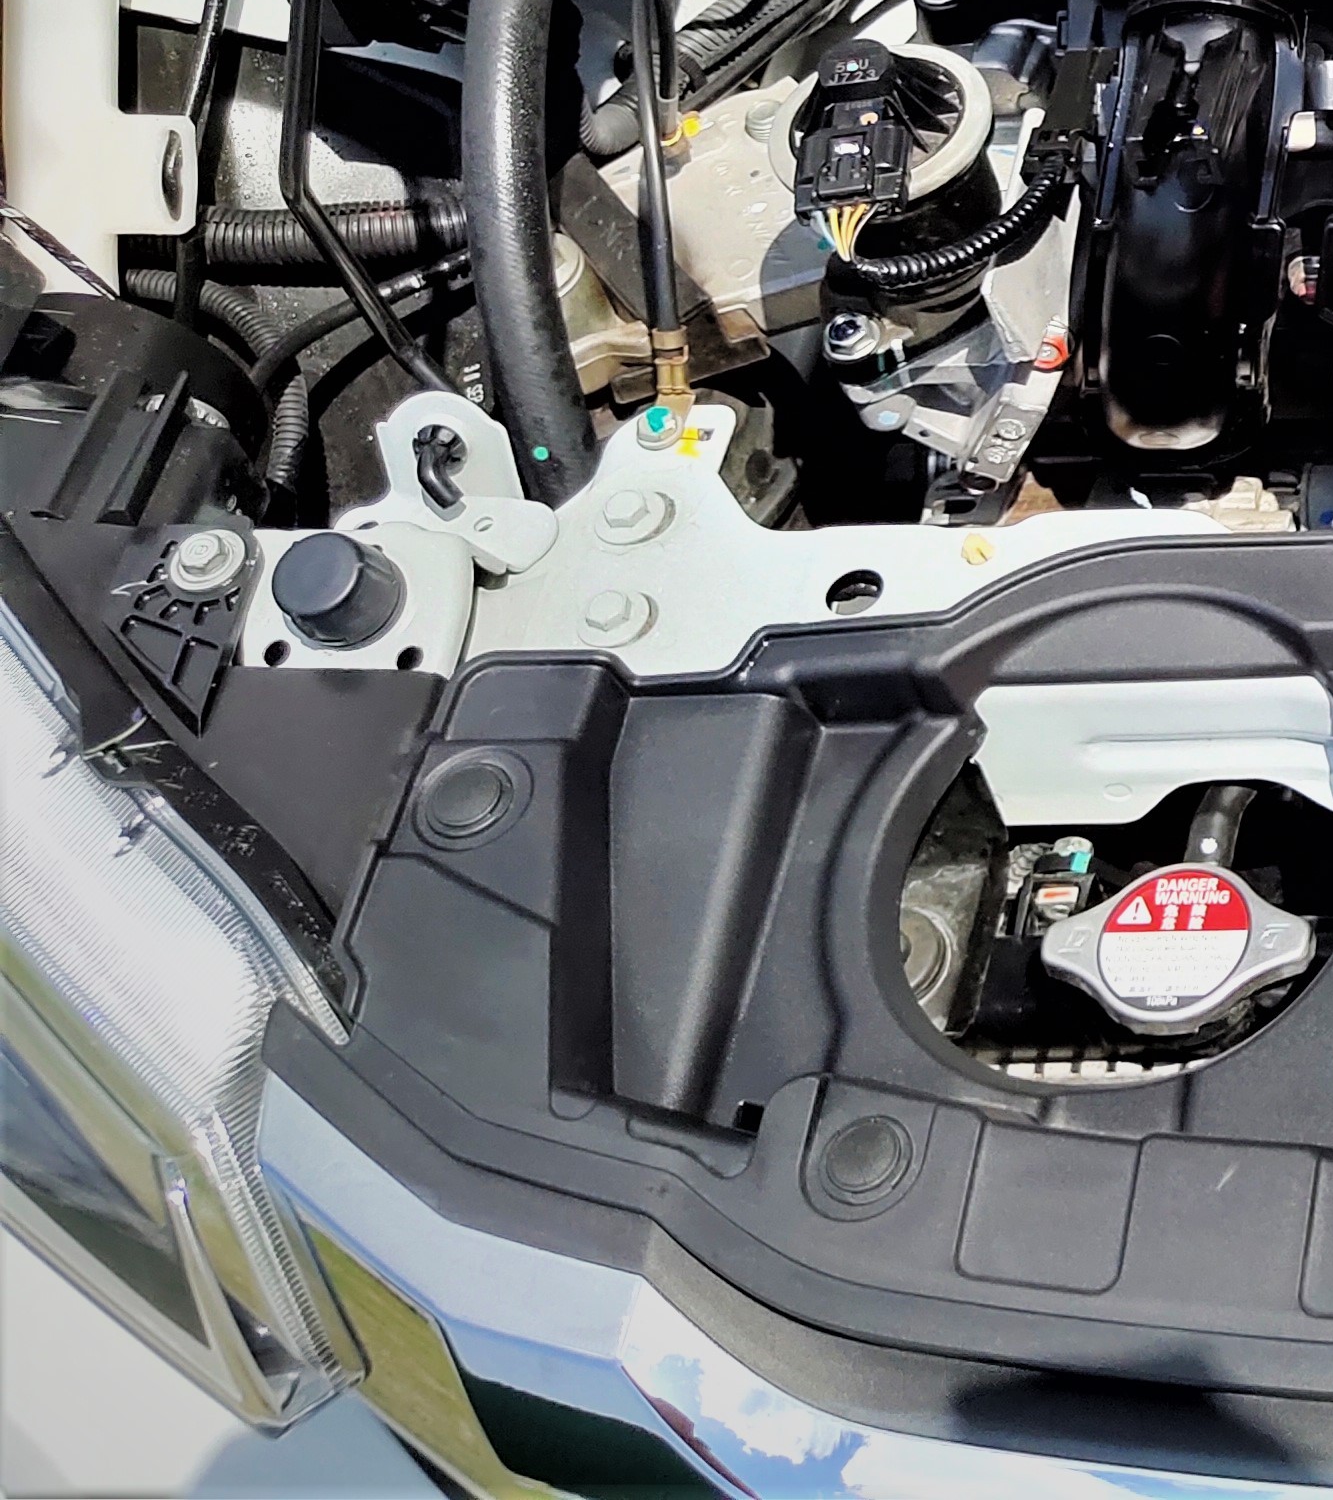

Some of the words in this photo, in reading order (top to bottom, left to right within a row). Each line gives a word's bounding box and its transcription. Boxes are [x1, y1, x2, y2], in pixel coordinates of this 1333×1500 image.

[834, 58, 870, 73] 5U
[1155, 877, 1219, 892] DANGER
[1154, 889, 1231, 906] WARNUNG
